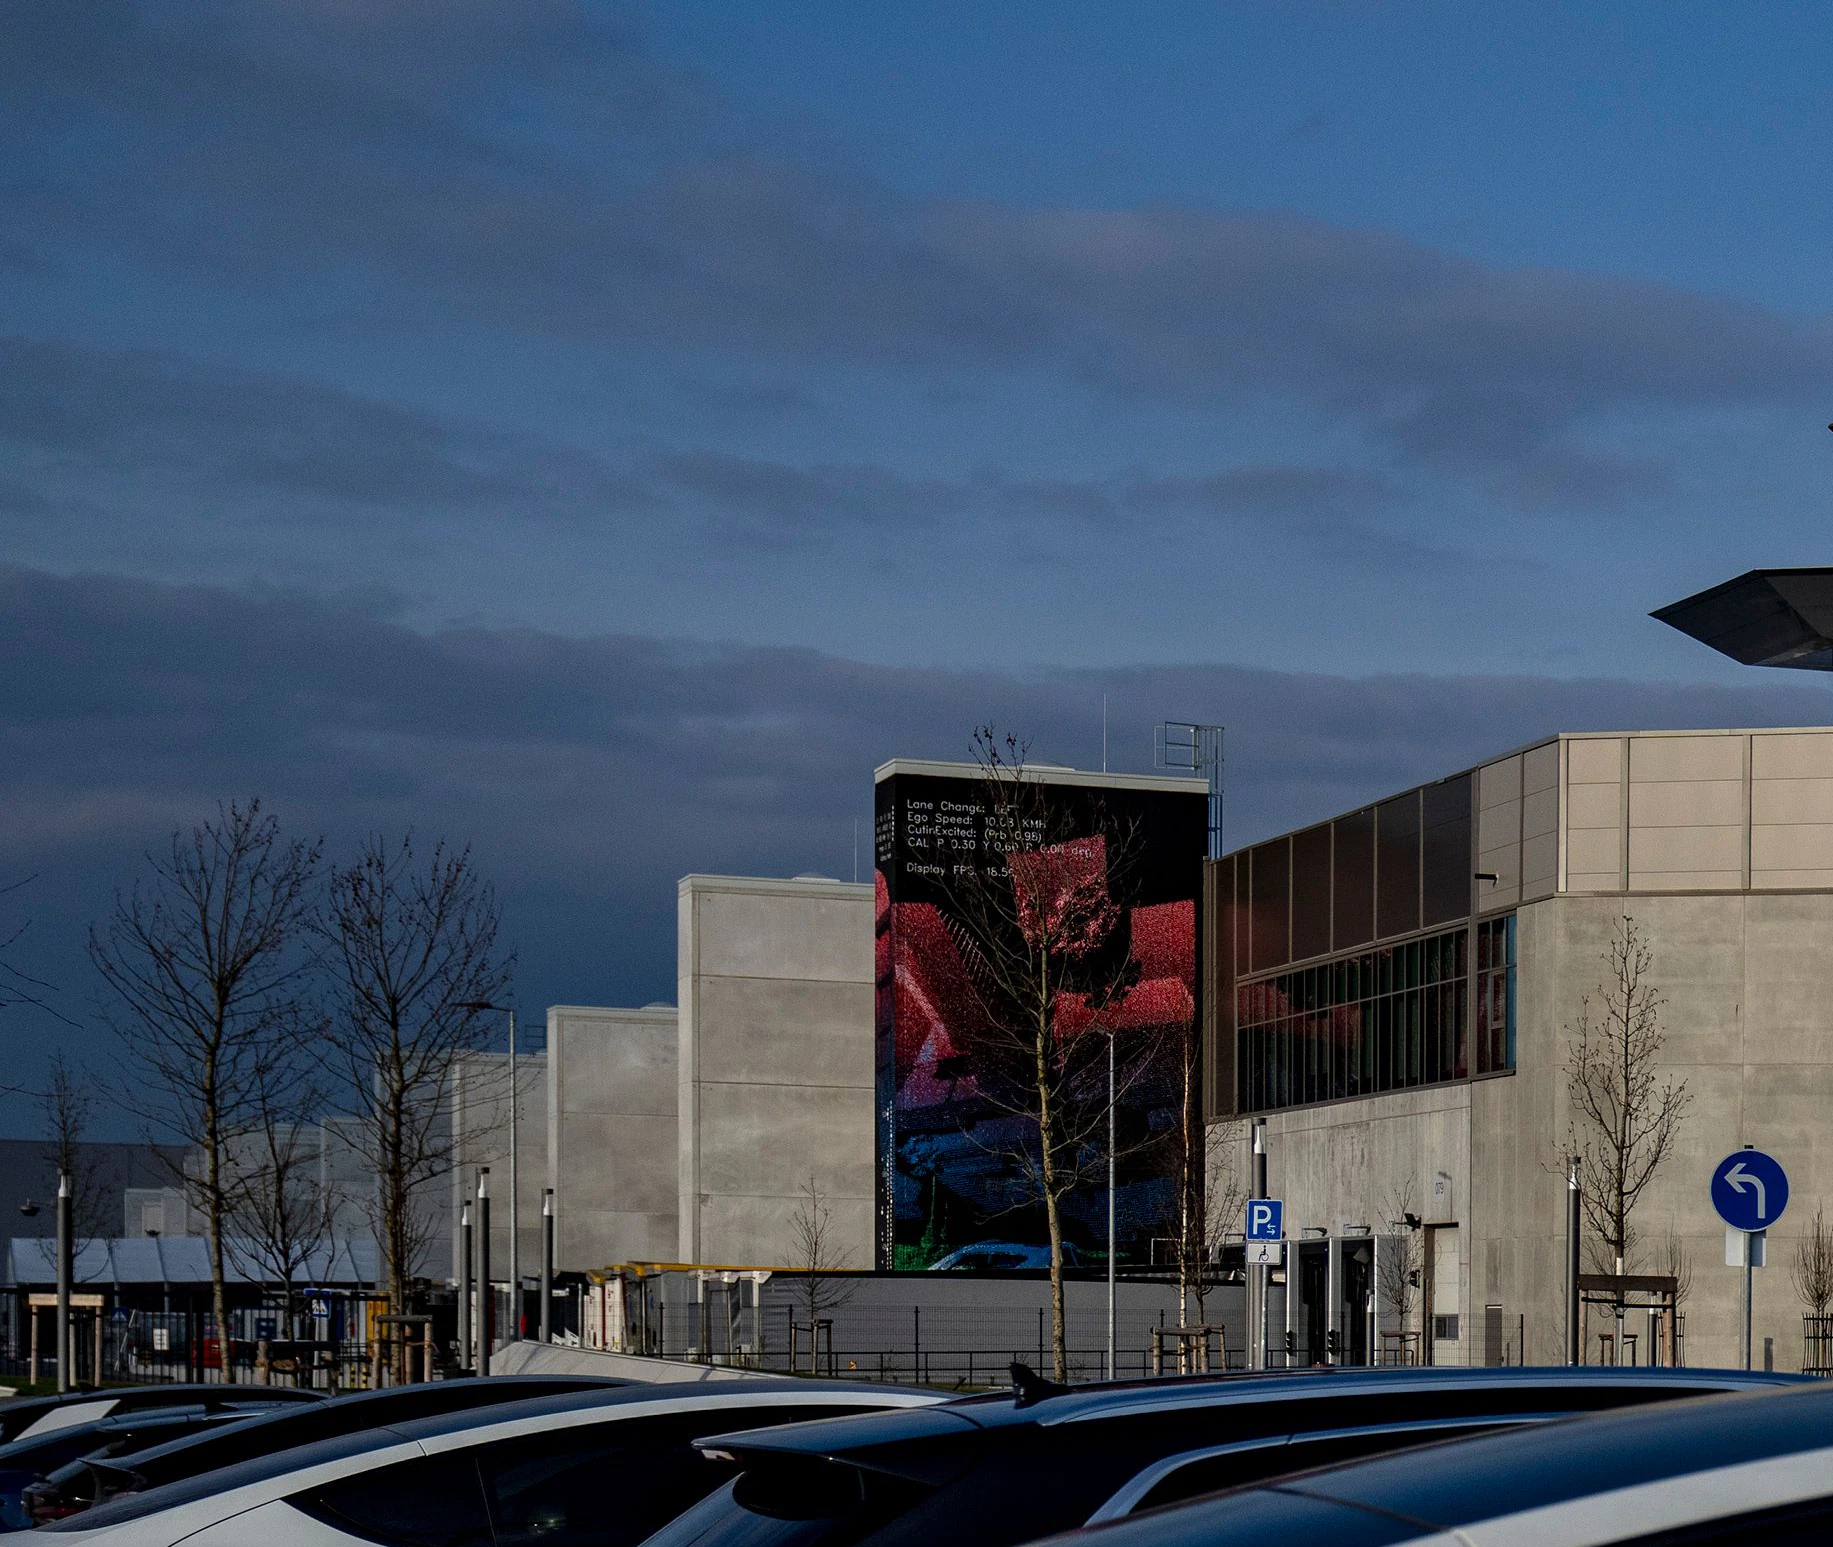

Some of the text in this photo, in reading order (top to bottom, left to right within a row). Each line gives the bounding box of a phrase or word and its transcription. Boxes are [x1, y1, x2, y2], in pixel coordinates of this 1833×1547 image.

[907, 799, 934, 810] Lane
[907, 812, 929, 824] Ego
[935, 813, 973, 825] Speed:
[907, 838, 929, 848] CAL
[937, 839, 945, 848] P
[906, 862, 946, 876] Display
[1253, 1205, 1272, 1235] P
